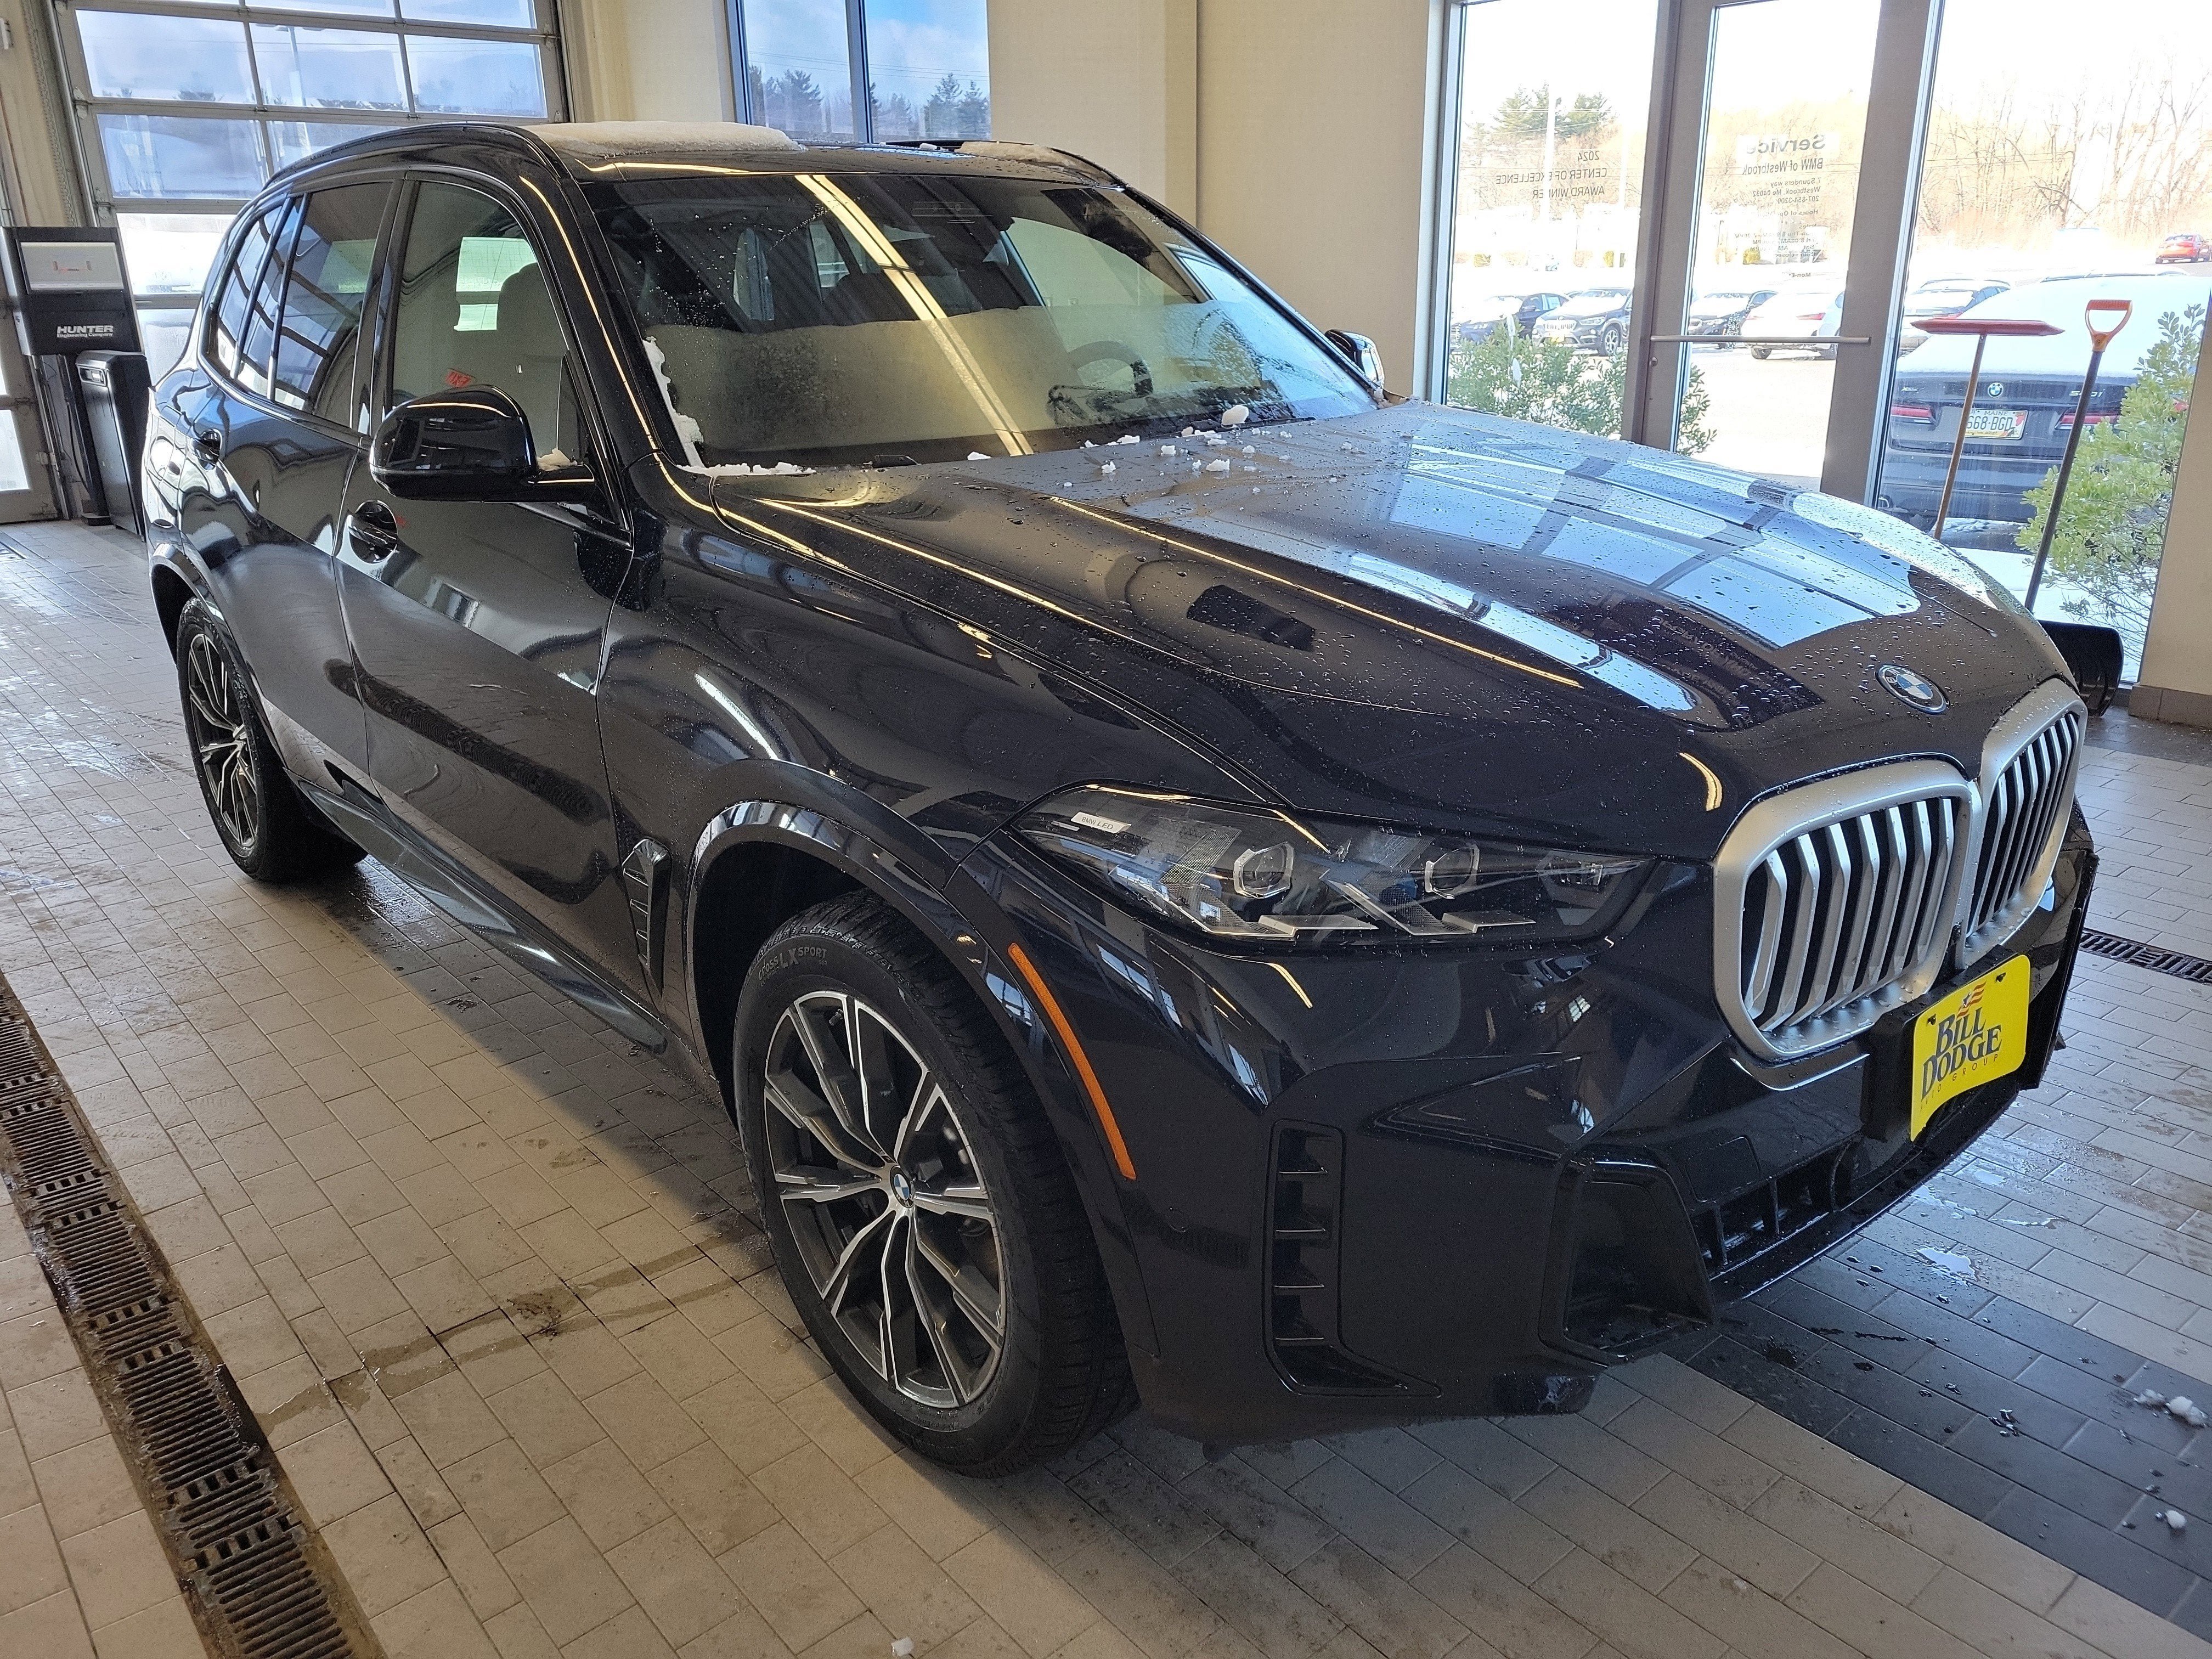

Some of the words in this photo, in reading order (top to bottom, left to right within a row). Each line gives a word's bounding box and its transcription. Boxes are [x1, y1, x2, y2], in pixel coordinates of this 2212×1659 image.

[57, 325, 114, 334] HUNTER
[1081, 816, 1097, 825] BMW
[1097, 821, 1114, 830] LED
[798, 946, 828, 958] SPORT
[1936, 1006, 1987, 1057] BILL
[1921, 1024, 2003, 1102] DODGE
[1951, 1053, 1999, 1081] GROUP
